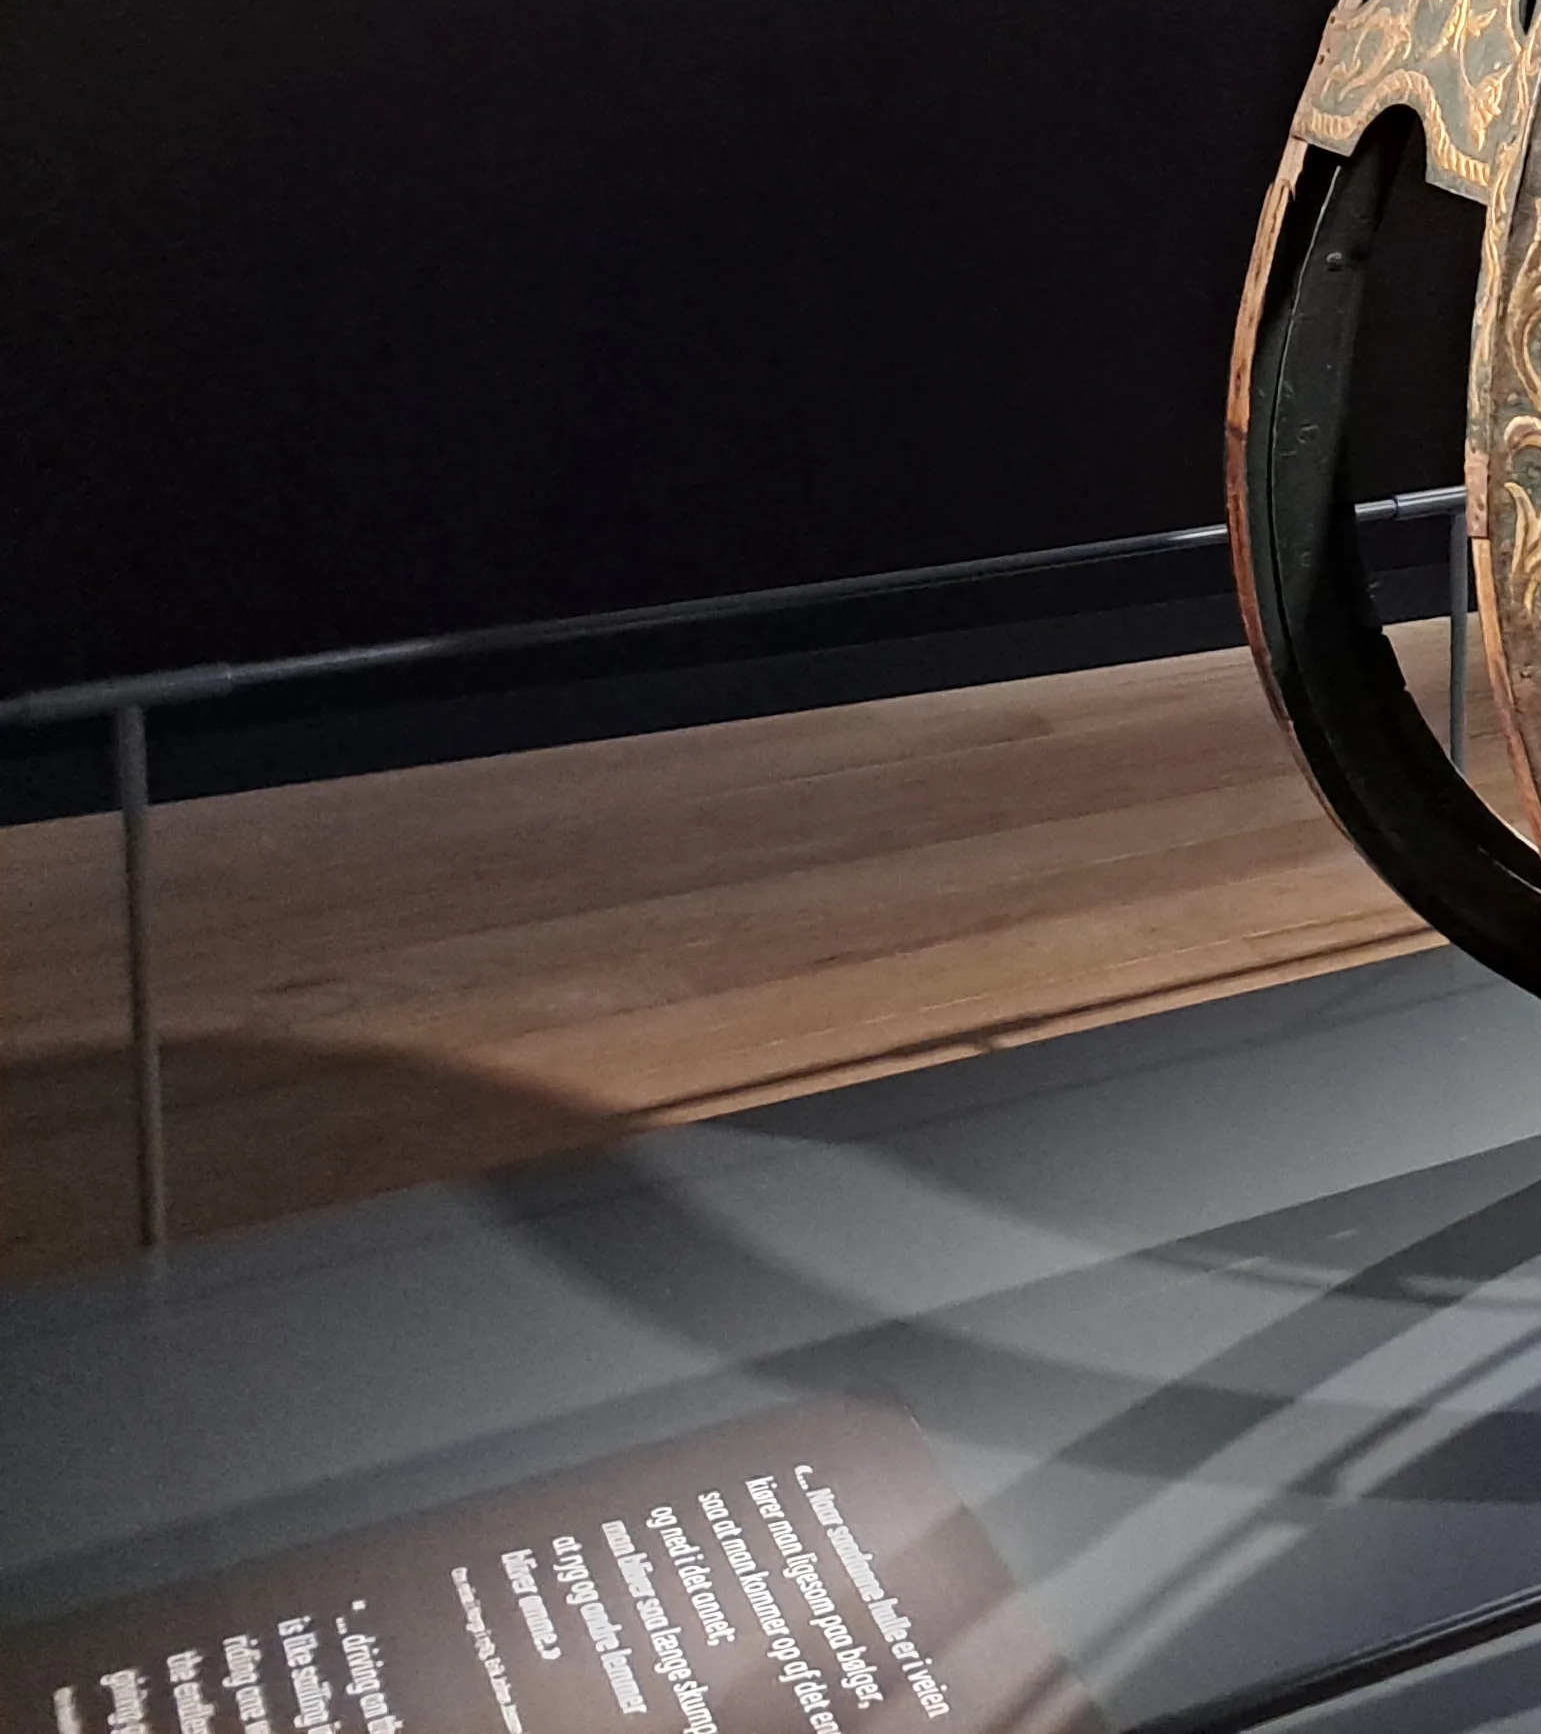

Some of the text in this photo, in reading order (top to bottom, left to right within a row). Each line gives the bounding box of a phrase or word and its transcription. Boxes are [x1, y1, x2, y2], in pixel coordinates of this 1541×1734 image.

[646, 1507, 678, 1528] og
[806, 1488, 844, 1526] Naar
[553, 1537, 582, 1556] at
[660, 1528, 701, 1558] ned
[768, 1521, 803, 1557] man
[553, 1555, 589, 1582] ryg
[674, 1554, 704, 1566] i
[602, 1521, 636, 1558] man
[637, 1598, 669, 1632] saa
[679, 1566, 713, 1594] det
[783, 1553, 835, 1616] ligesom
[566, 1581, 599, 1605] og
[278, 1616, 311, 1636] is
[698, 1492, 842, 1734] saa at man kommer op af det en
[868, 1598, 912, 1643] hulle
[810, 1615, 853, 1650] paa
[283, 1633, 318, 1668] like
[342, 1635, 384, 1695] driving
[892, 1642, 920, 1660] er
[902, 1658, 933, 1672] i
[360, 1693, 388, 1719] on
[908, 1670, 950, 1719] veien
